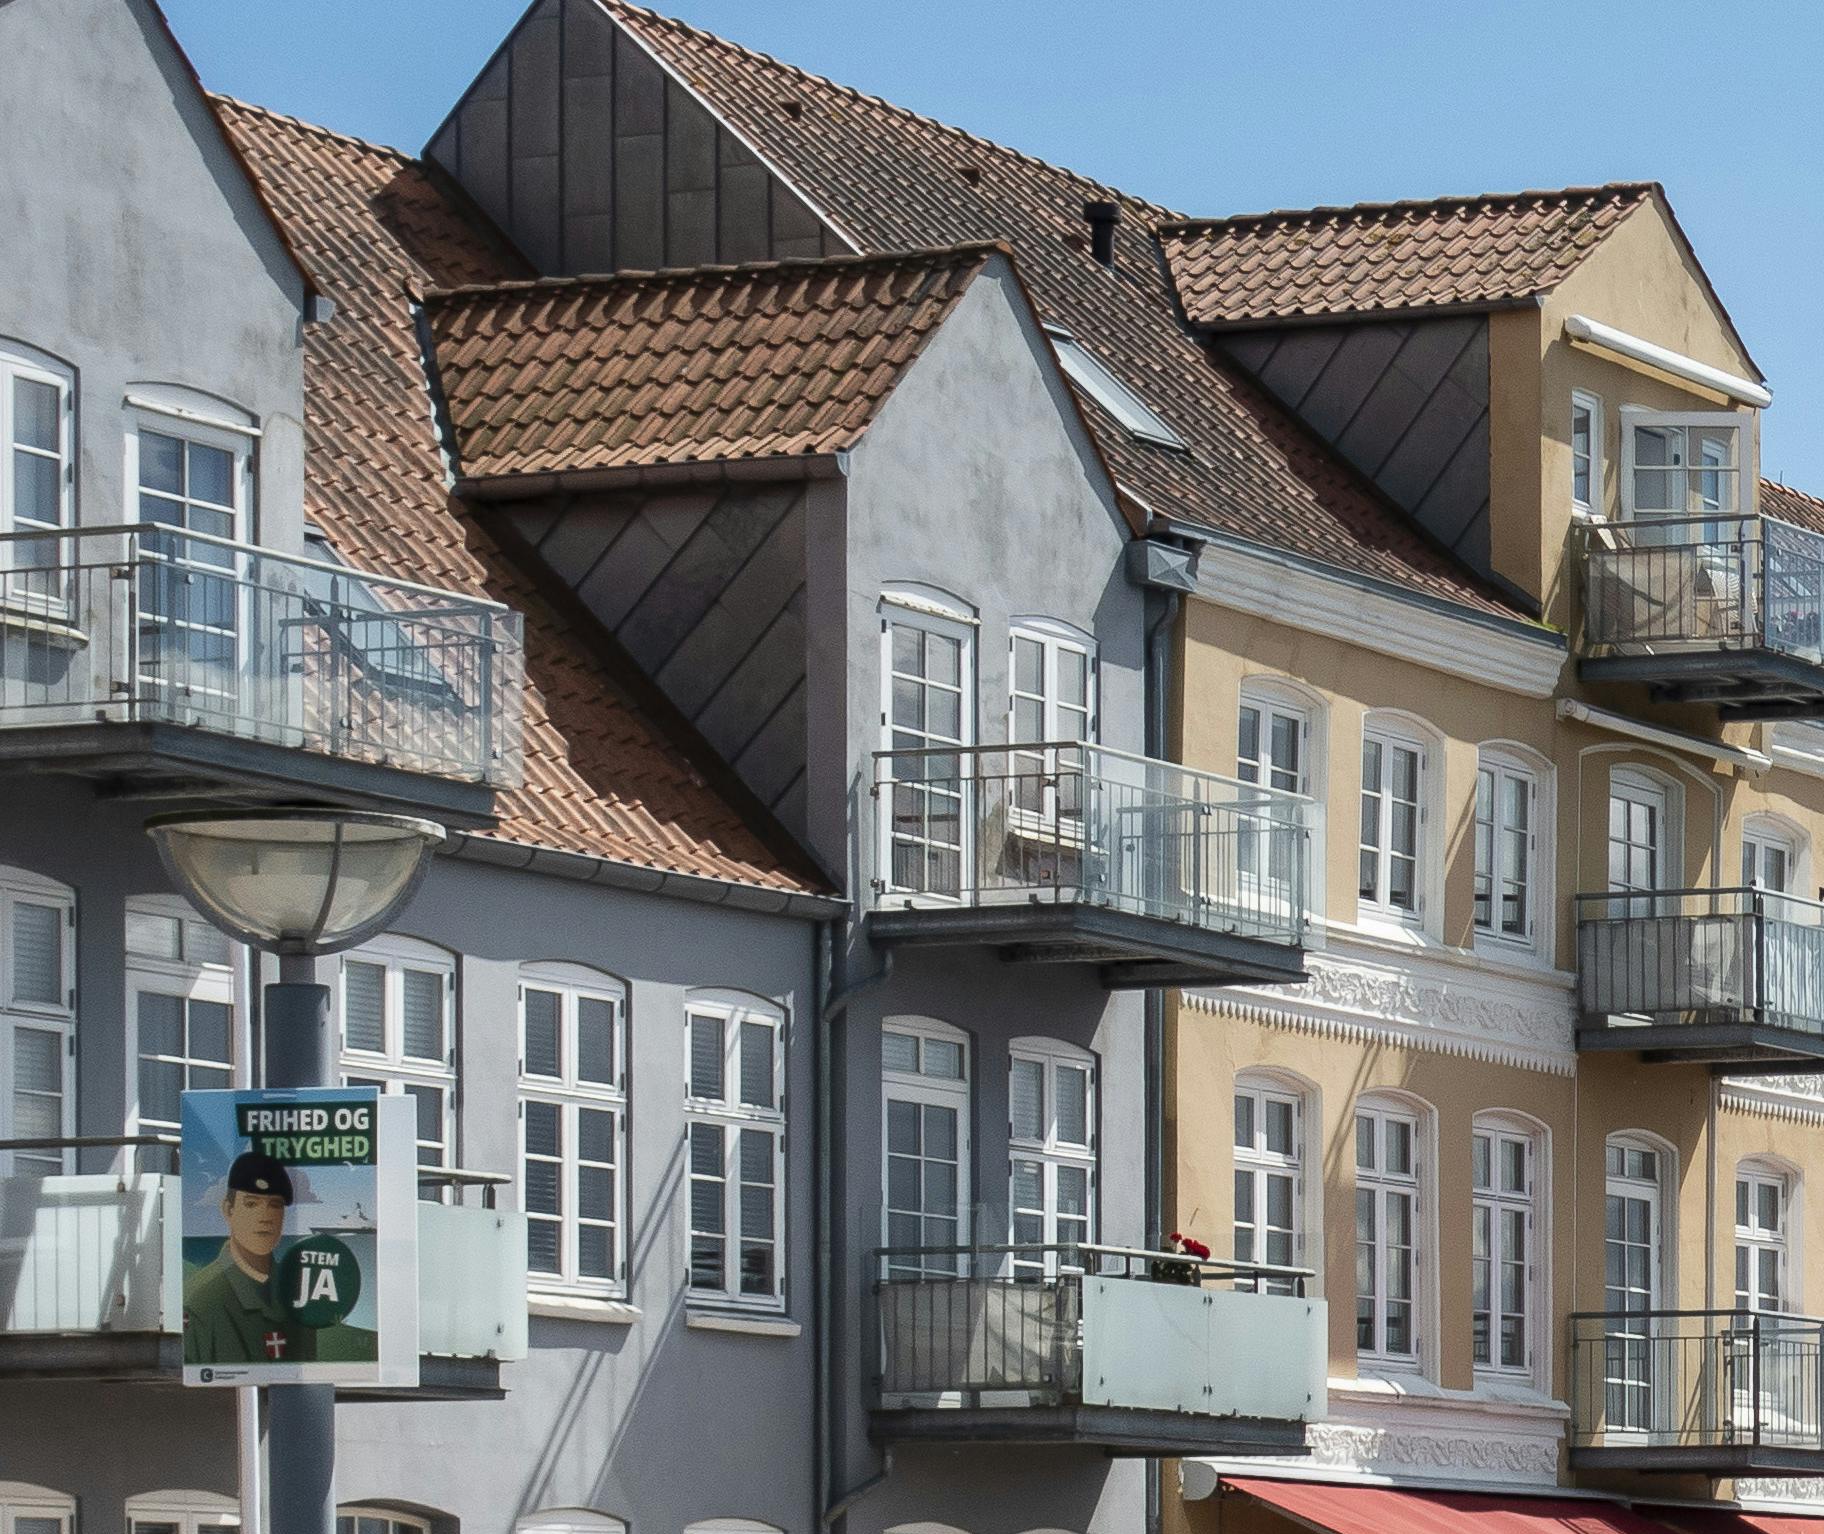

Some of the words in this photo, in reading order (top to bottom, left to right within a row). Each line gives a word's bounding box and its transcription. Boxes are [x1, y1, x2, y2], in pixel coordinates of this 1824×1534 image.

[247, 1109, 328, 1132] FRIHED
[334, 1108, 370, 1130] OG
[262, 1135, 370, 1159] TRYGHED
[301, 1250, 340, 1267] STEM
[293, 1267, 340, 1309] JA
